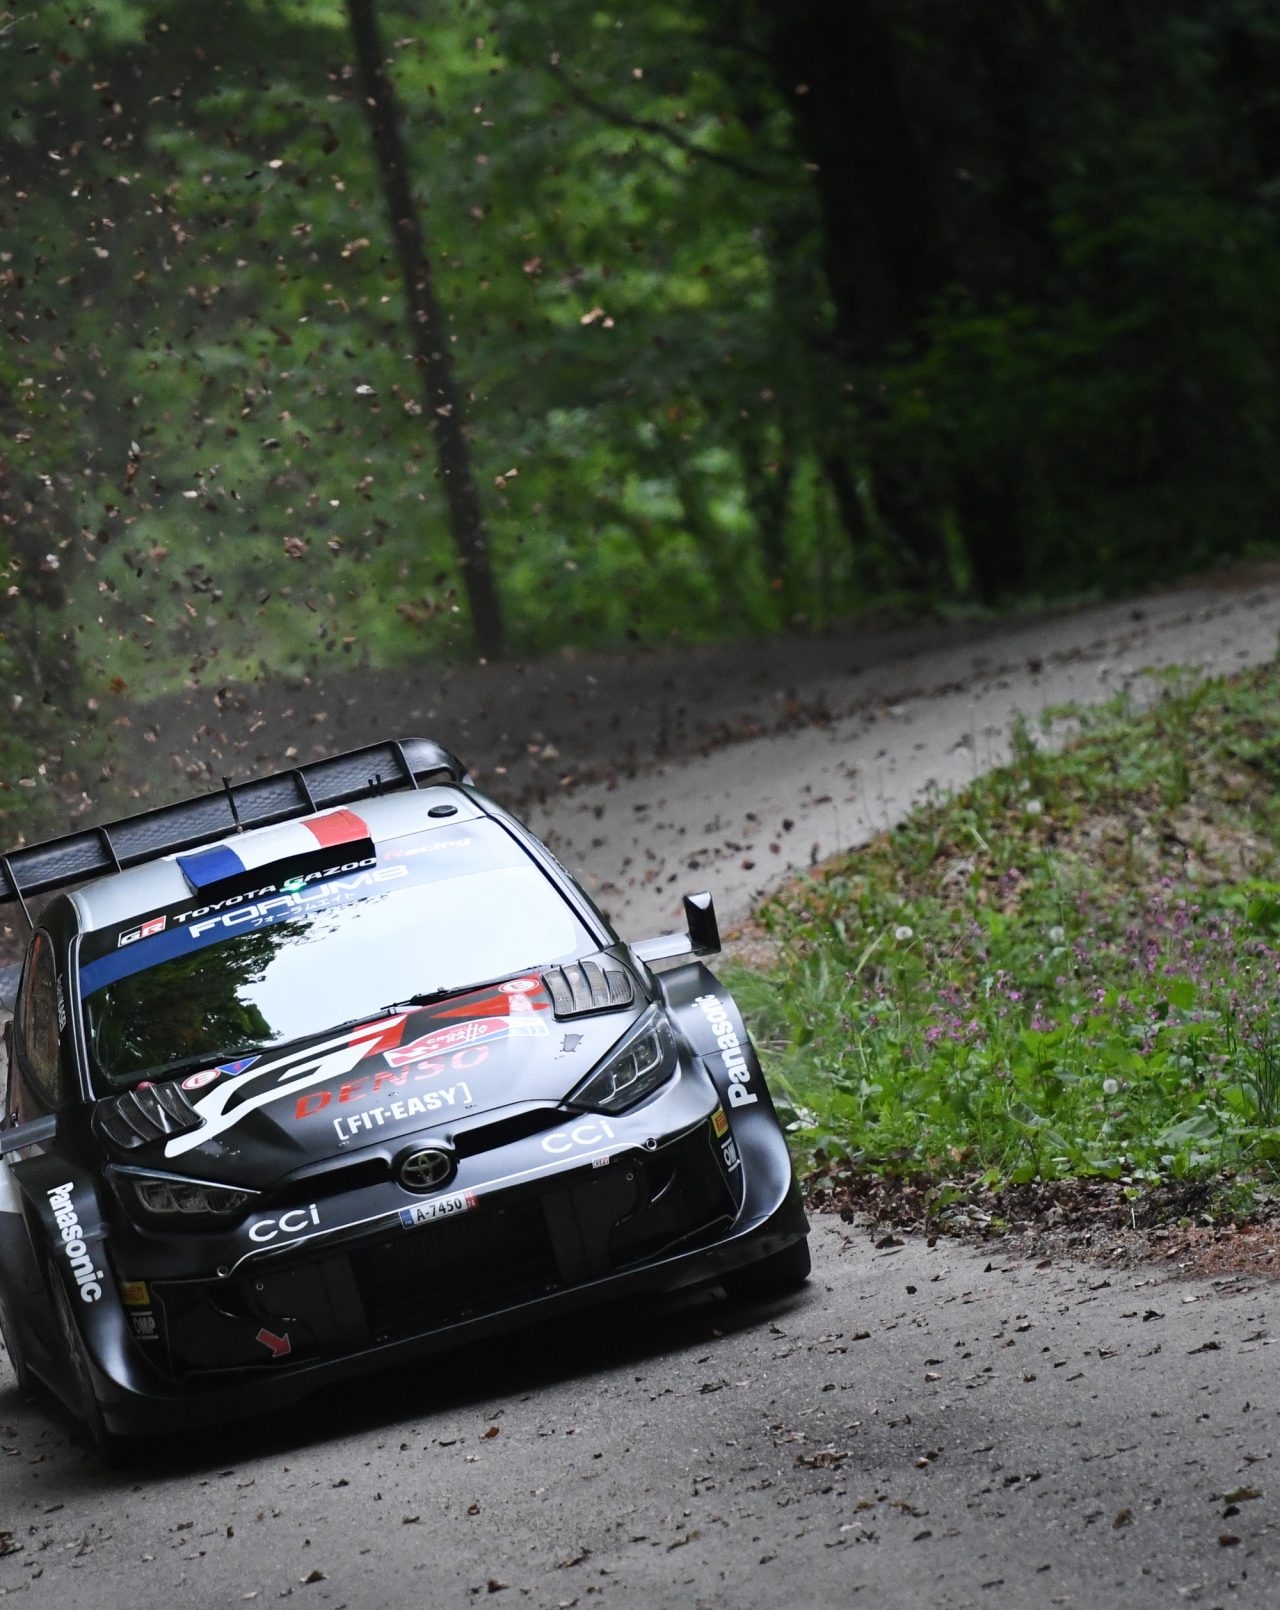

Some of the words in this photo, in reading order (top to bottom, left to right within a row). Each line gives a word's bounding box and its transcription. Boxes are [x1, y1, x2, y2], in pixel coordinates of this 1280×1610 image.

[119, 917, 165, 946] GR
[172, 885, 277, 923] TOYOTA
[279, 857, 377, 893] GAZOO
[188, 864, 409, 939] FORUM8
[293, 1046, 490, 1120] DENSO
[691, 994, 759, 1108] Panasonic
[46, 1181, 105, 1303] Panasonic
[416, 1199, 463, 1223] A-7450
